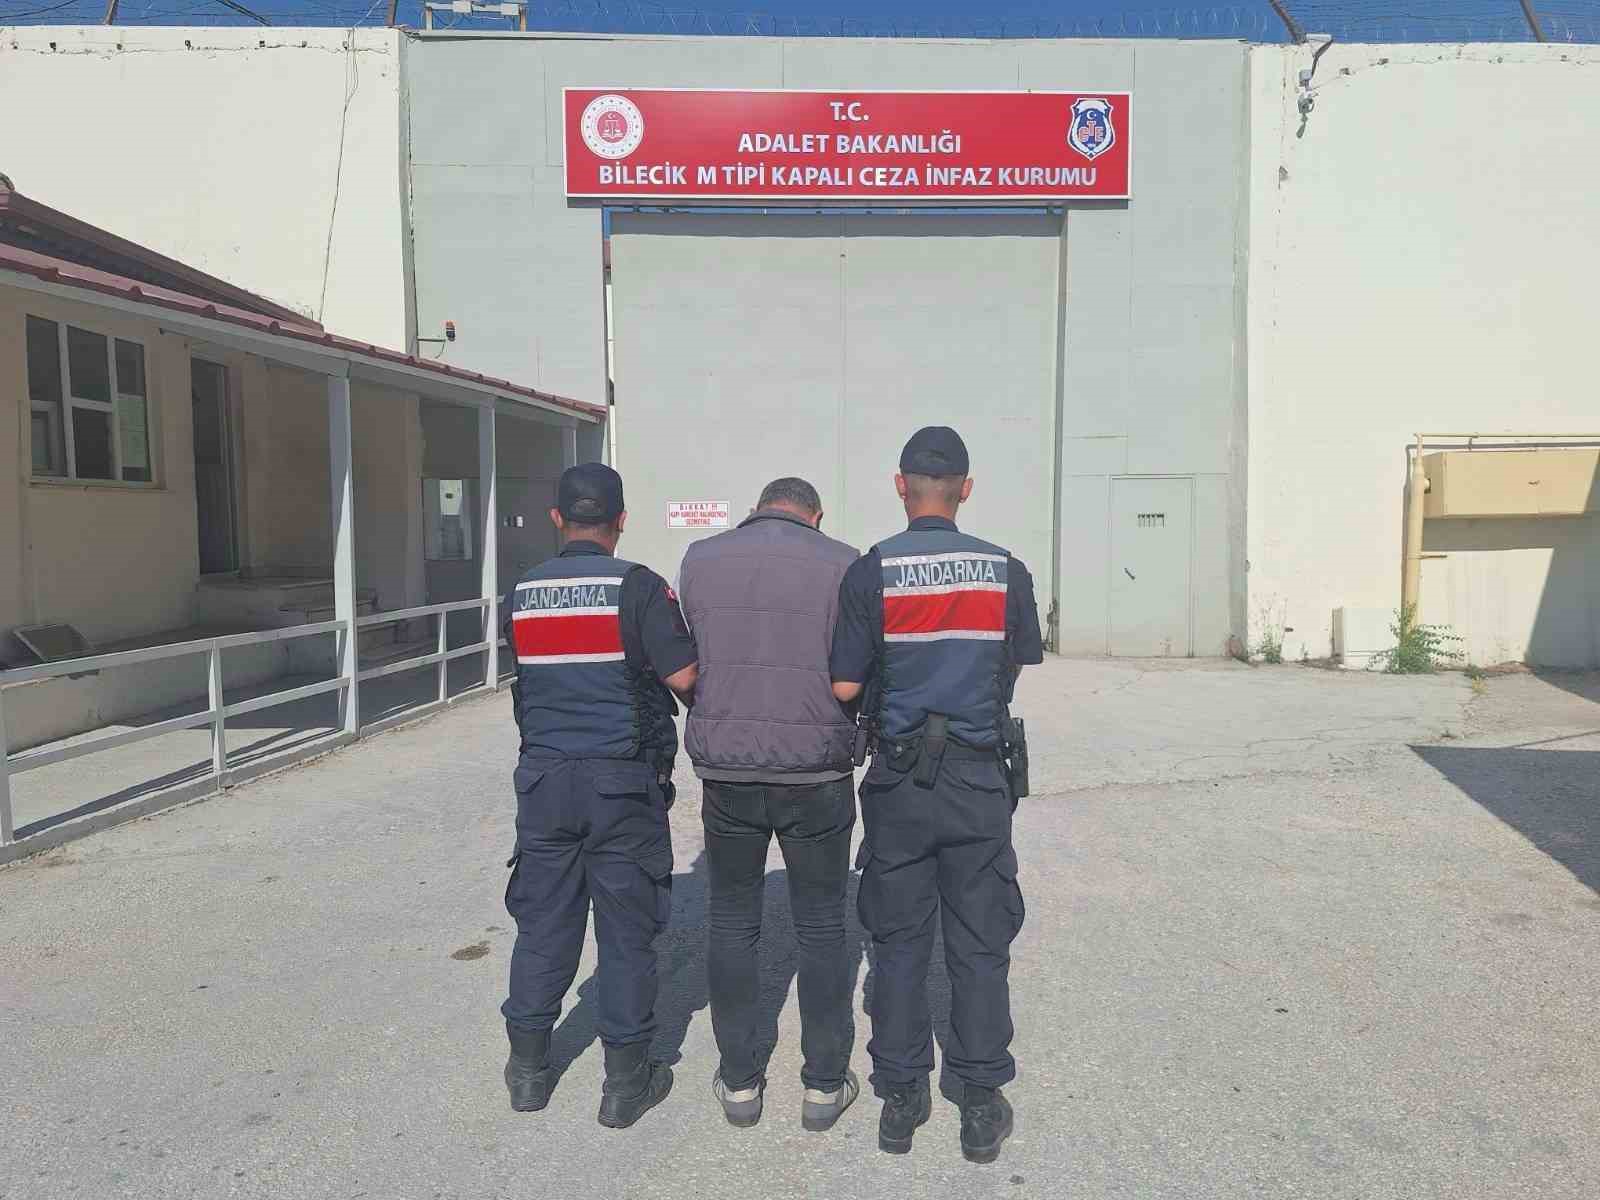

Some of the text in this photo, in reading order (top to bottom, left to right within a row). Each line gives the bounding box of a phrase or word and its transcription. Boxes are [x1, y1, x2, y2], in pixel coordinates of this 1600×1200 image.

[830, 102, 869, 121] T.C.
[738, 130, 962, 154] ADALET BAKANLIĞI
[599, 161, 1097, 186] BİLECİK M TİPİ KAPALI CEZA İNFAZ KURUMU
[895, 562, 996, 587] JANDARMA
[520, 586, 608, 610] JANDARMA
